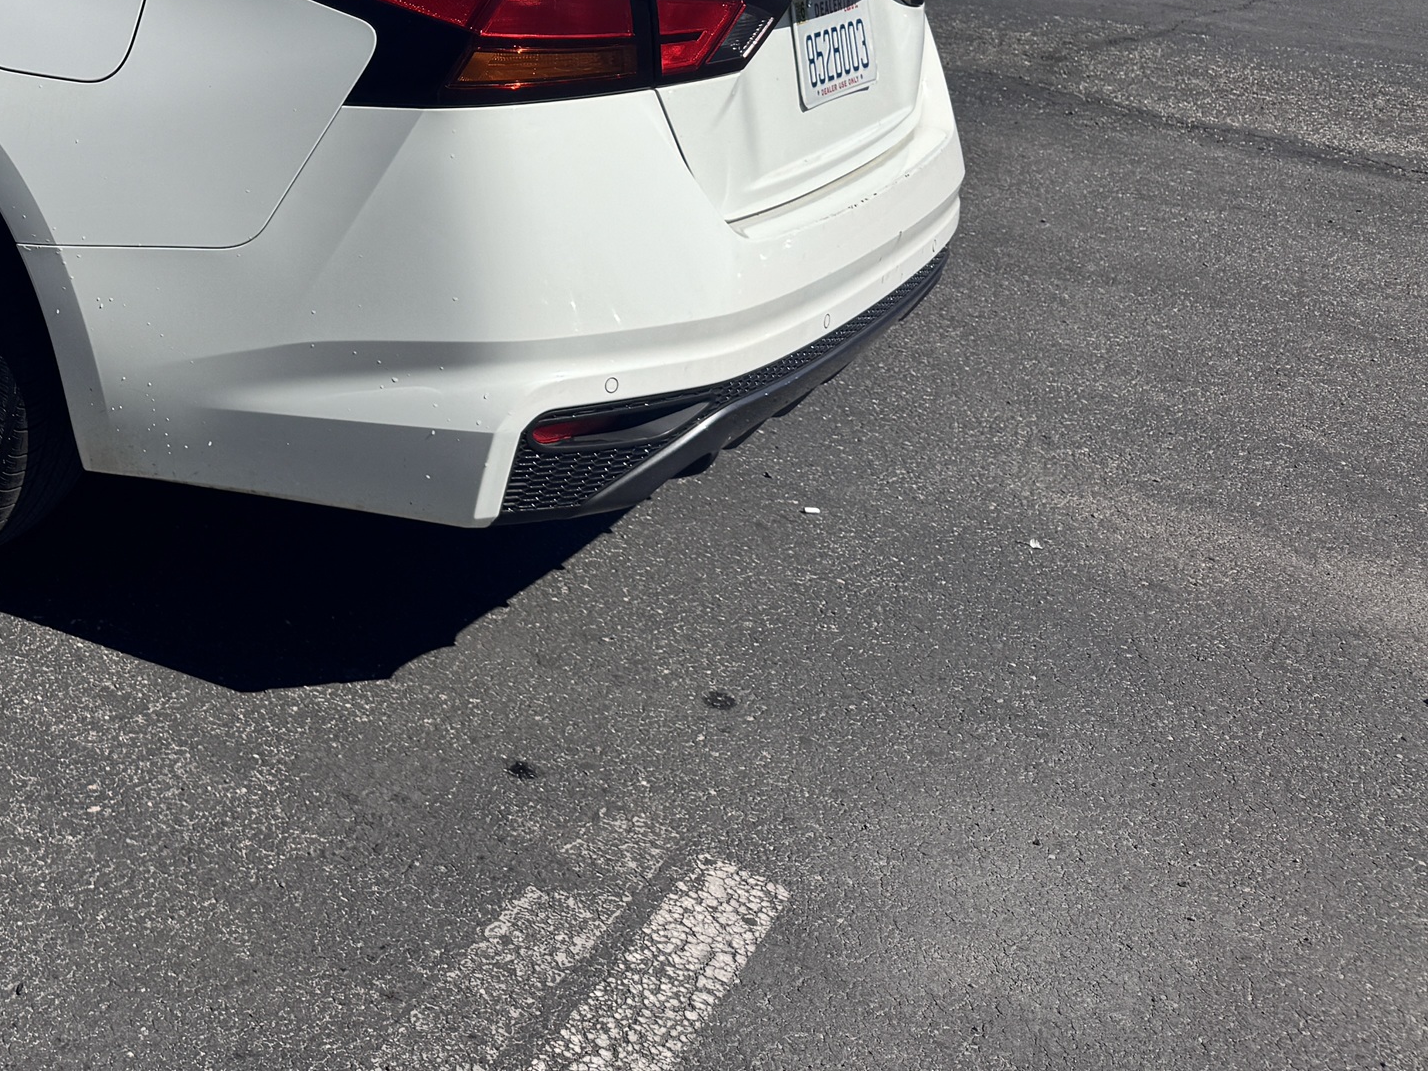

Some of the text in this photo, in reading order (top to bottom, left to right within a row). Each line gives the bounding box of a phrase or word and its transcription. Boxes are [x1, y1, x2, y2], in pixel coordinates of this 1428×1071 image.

[806, 18, 870, 88] 852B003
[821, 76, 859, 96] DEALER USE ONLY
